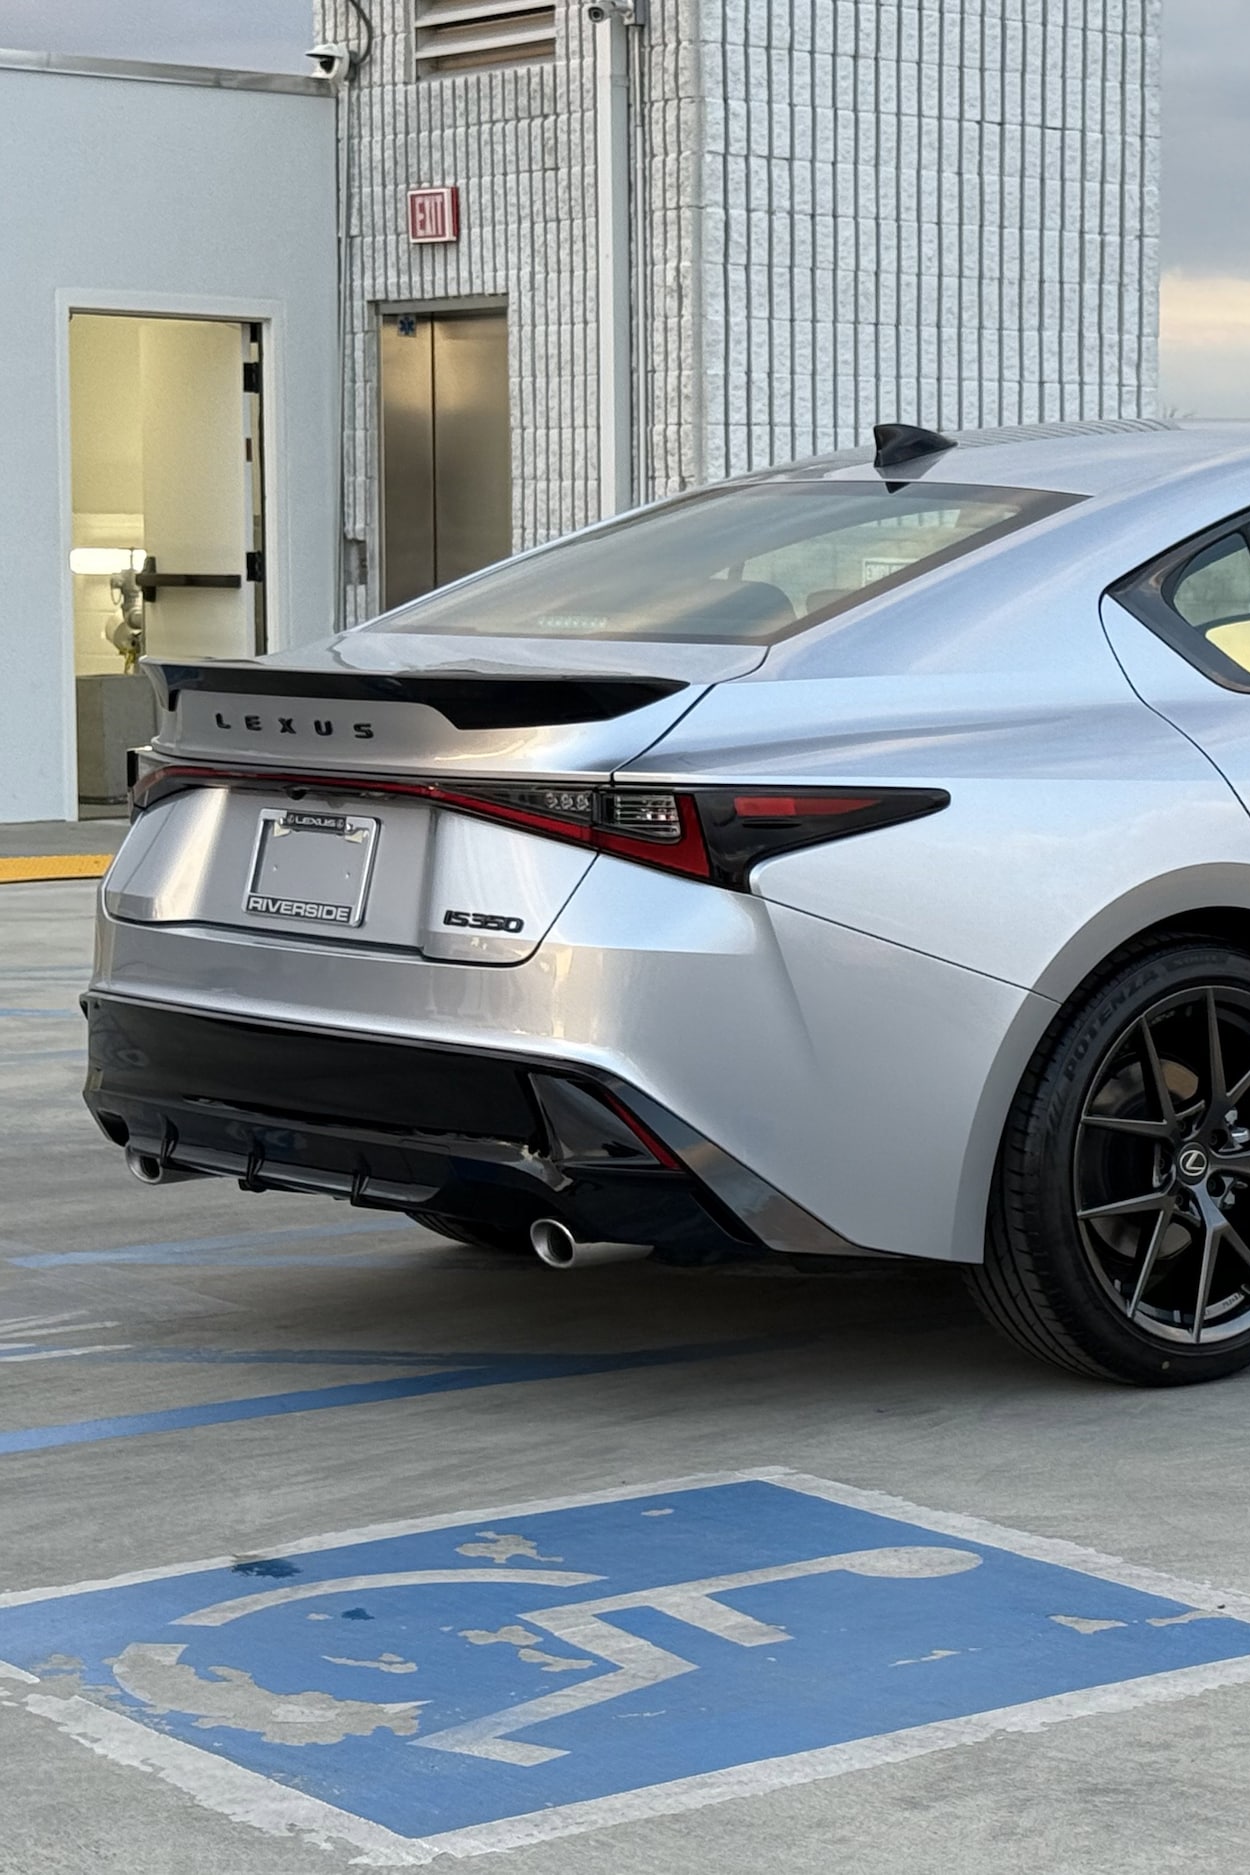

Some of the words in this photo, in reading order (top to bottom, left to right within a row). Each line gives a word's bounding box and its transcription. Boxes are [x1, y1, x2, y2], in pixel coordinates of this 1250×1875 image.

[415, 194, 444, 237] EXIT
[215, 713, 374, 739] LEXUS
[295, 814, 336, 828] LEXUS
[249, 897, 350, 921] RIVERSIDE
